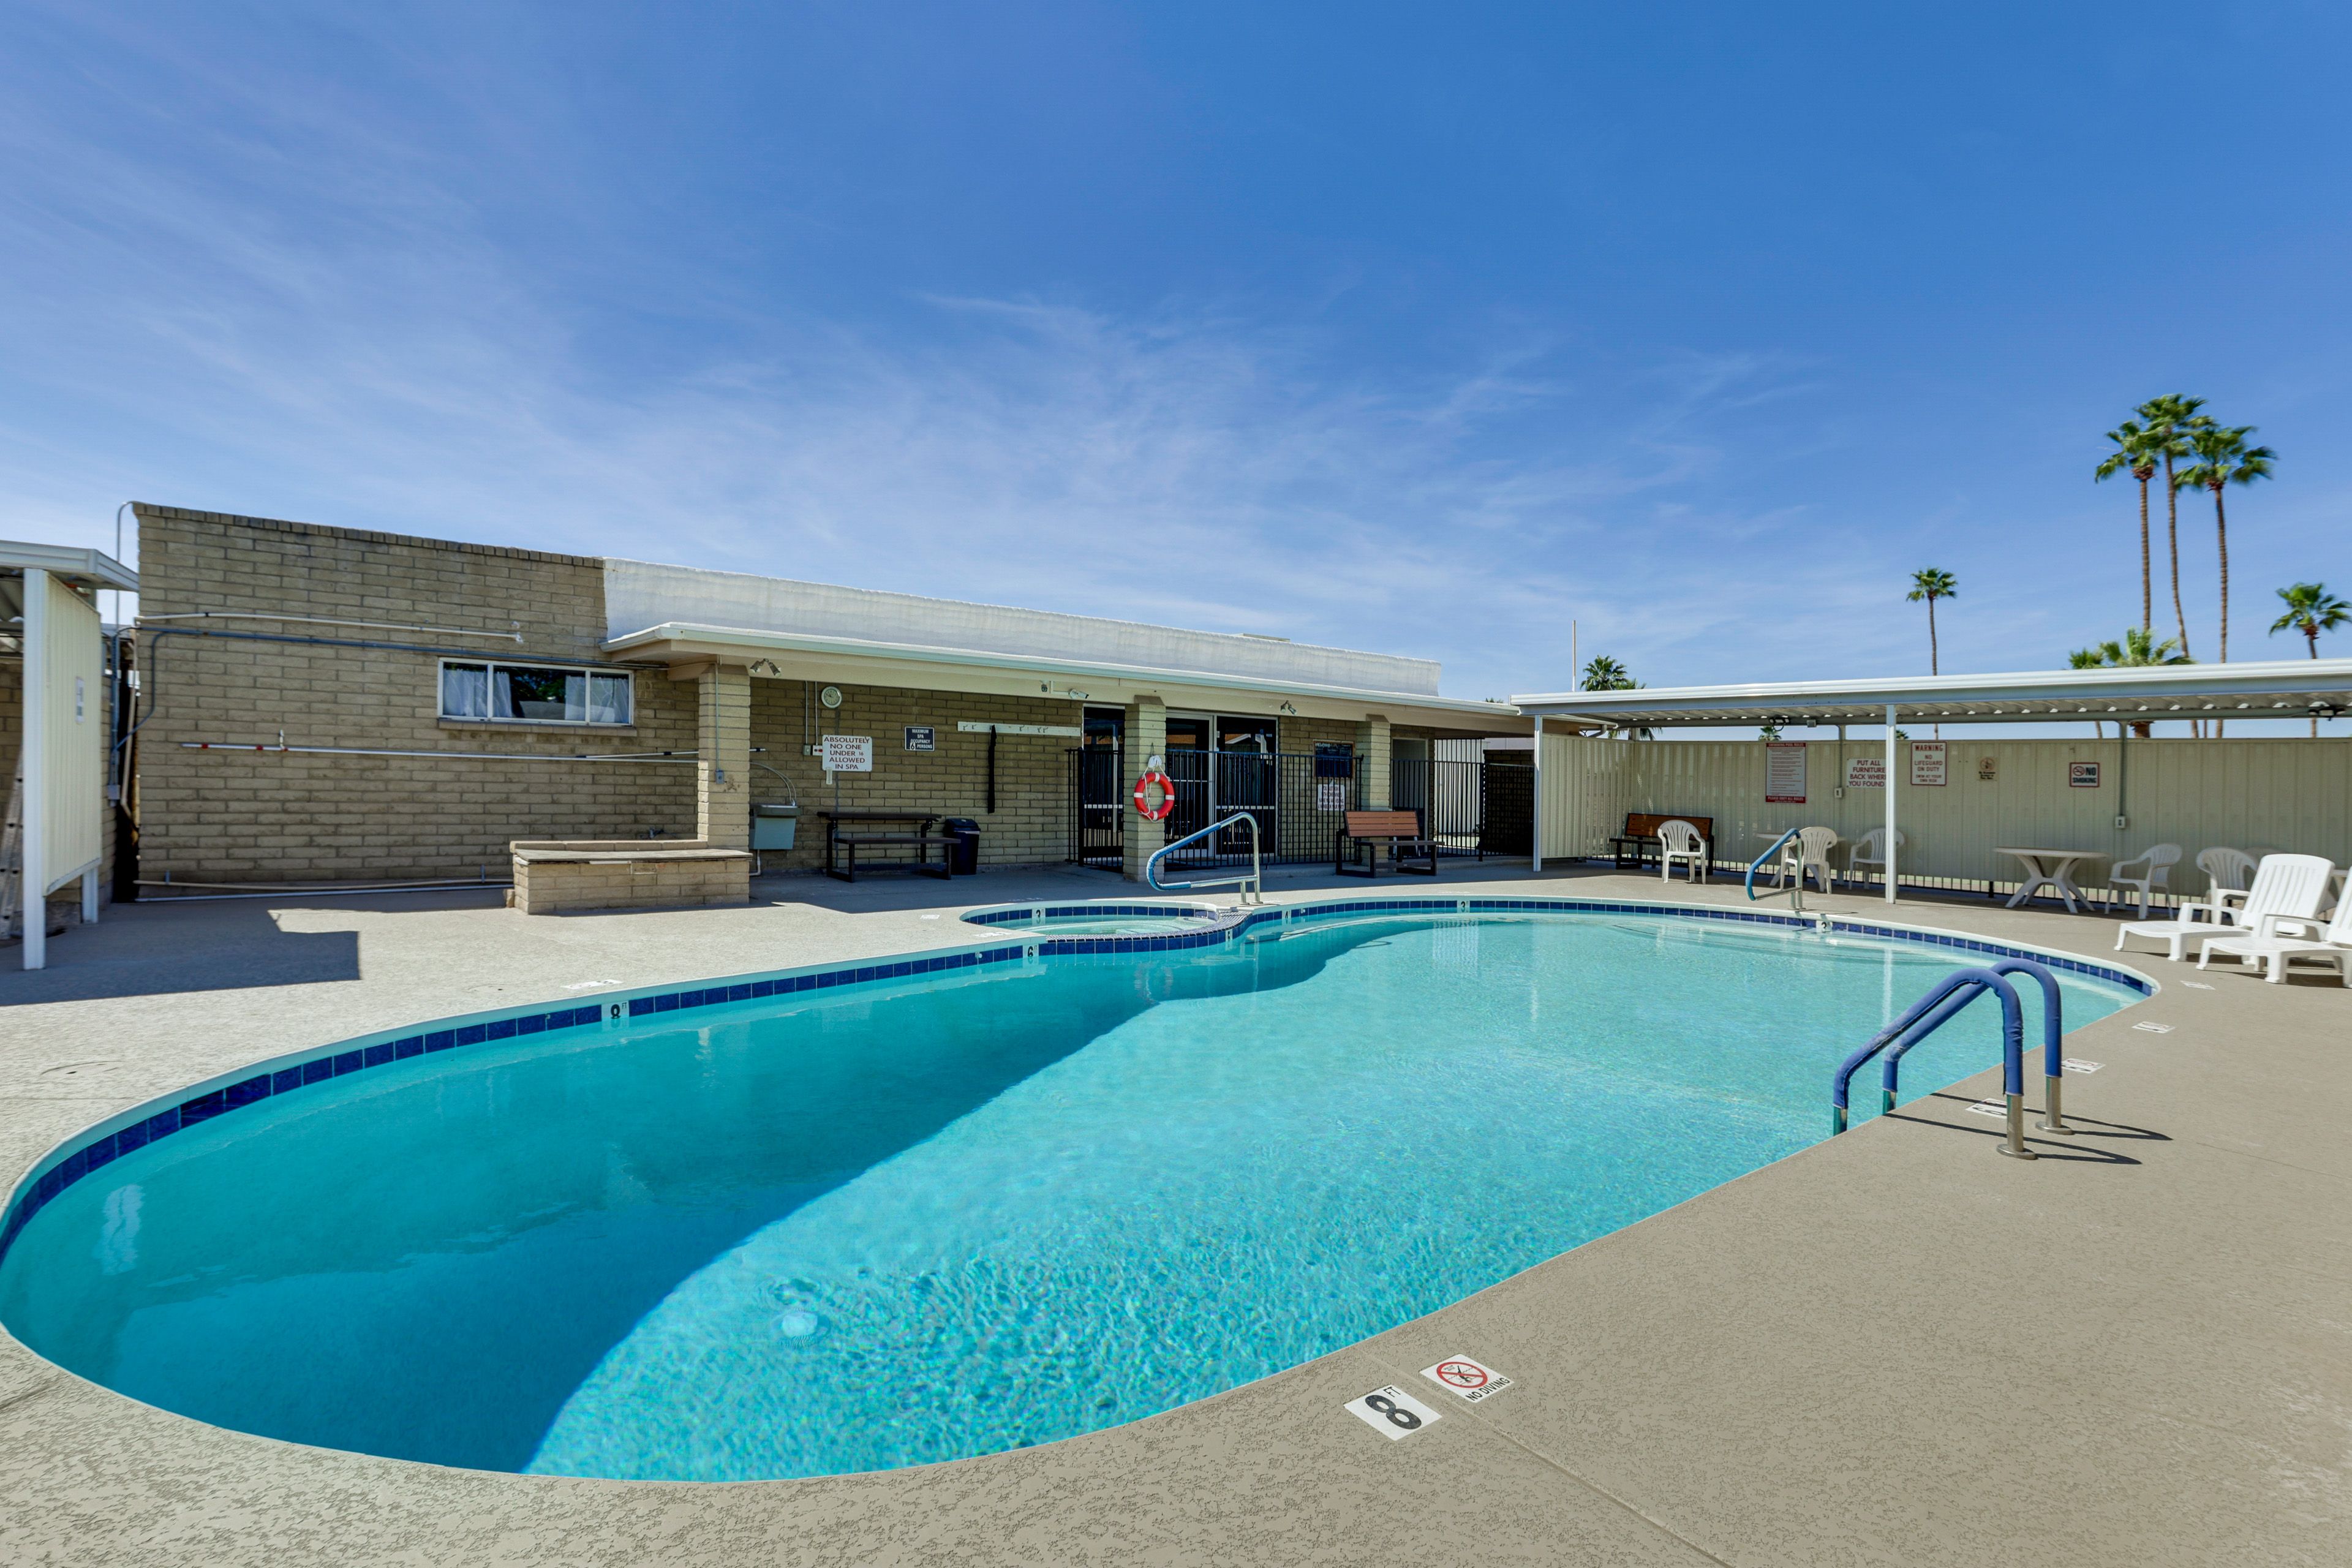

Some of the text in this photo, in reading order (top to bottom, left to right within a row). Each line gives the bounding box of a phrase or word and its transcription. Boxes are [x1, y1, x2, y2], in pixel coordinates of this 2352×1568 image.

[1465, 1377, 1510, 1401] NO DIVING
[1365, 1386, 1422, 1430] 8 FT
